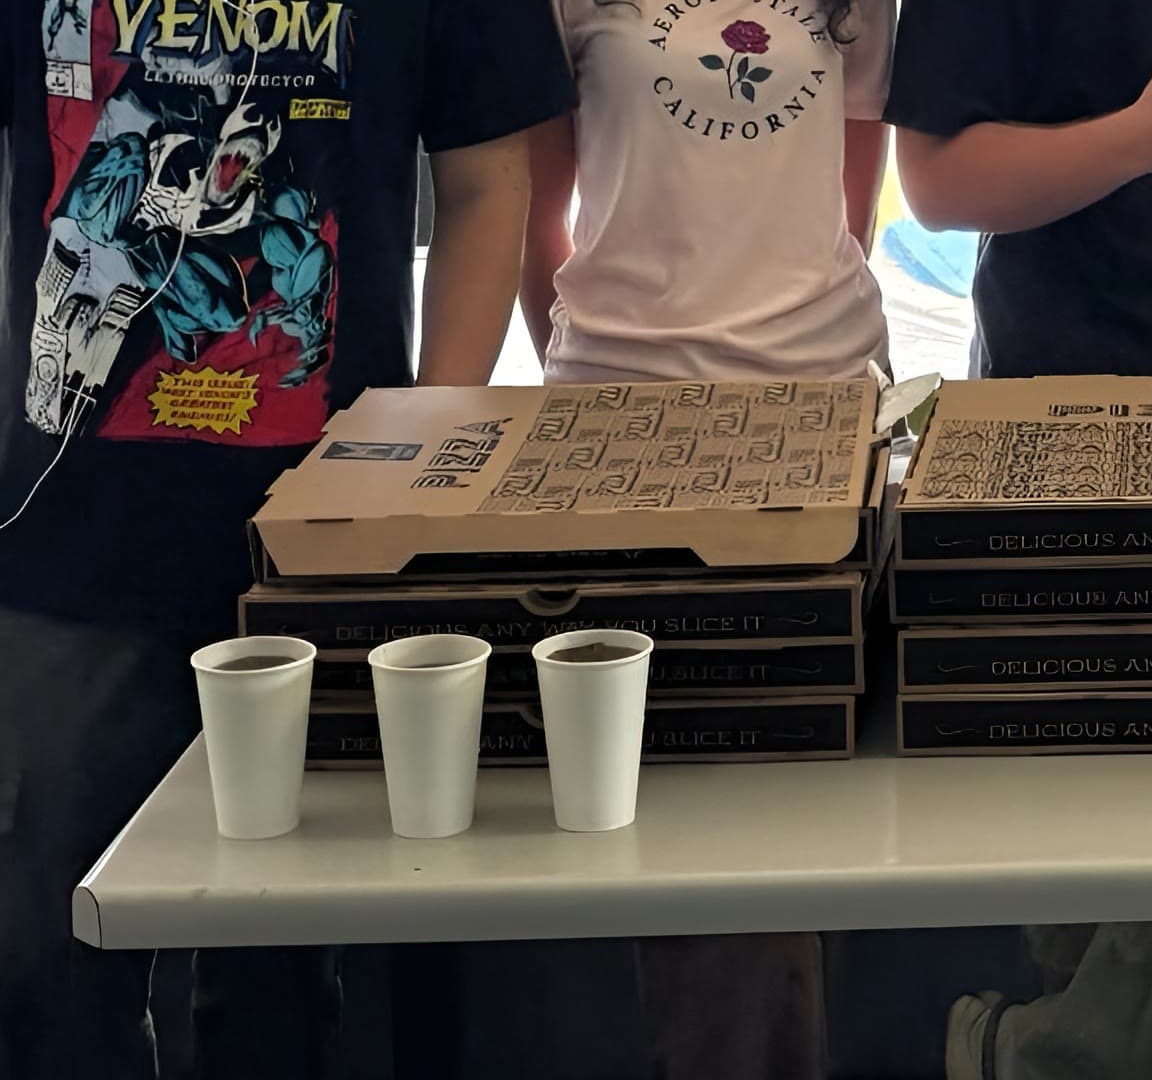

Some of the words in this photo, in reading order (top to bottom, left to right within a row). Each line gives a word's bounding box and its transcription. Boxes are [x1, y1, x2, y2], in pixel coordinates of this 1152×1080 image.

[653, 69, 827, 141] CALIFORNIA
[410, 416, 514, 490] PIZZA
[989, 533, 1115, 550] DELICIOUS
[981, 591, 1106, 607] DELICIOUS
[664, 617, 735, 633] SLICE
[744, 616, 765, 632] IT
[991, 658, 1117, 675] DELICIOUS
[989, 721, 1116, 739] DELICIOUS
